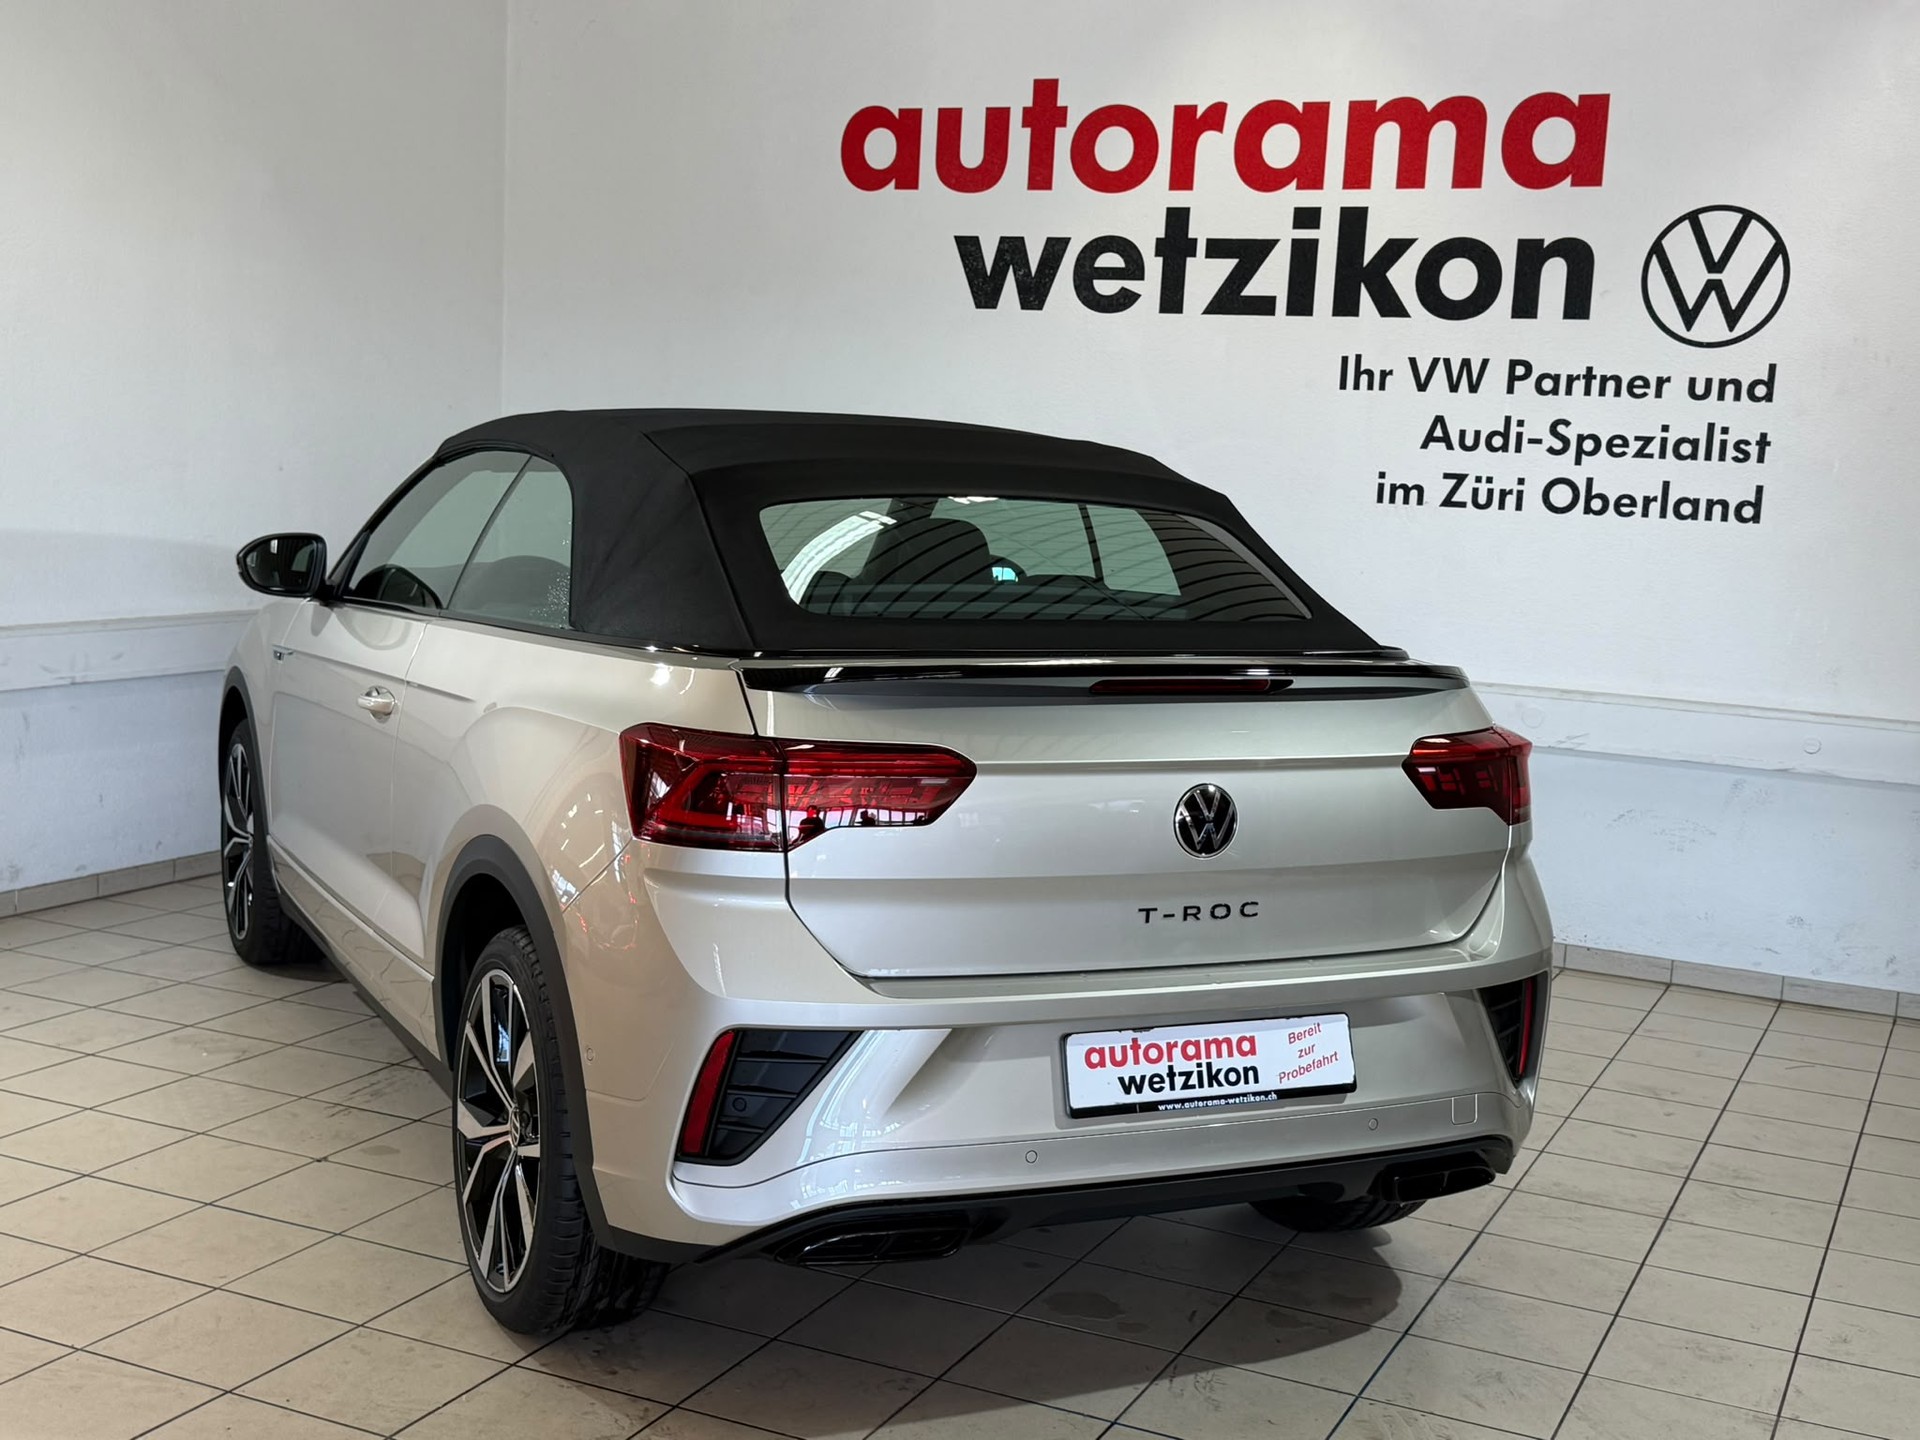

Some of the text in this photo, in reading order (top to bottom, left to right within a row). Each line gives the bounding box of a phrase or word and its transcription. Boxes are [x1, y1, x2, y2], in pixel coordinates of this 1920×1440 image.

[840, 79, 1611, 194] autorama
[953, 206, 1596, 321] wetzikon
[1339, 354, 1777, 403] Ihr VW Partner und
[1419, 414, 1772, 466] Audi-Spezialist
[1376, 471, 1764, 524] im Züri Oberland
[1138, 901, 1260, 924] T-ROC
[1288, 1022, 1321, 1045] Bereit
[1084, 1034, 1258, 1070] autorama
[1279, 1051, 1339, 1084] Probefahrt
[1297, 1043, 1316, 1059] zur
[1117, 1062, 1260, 1095] wetzikon
[1158, 1092, 1278, 1111] www.autorama-wetzikon.ch
